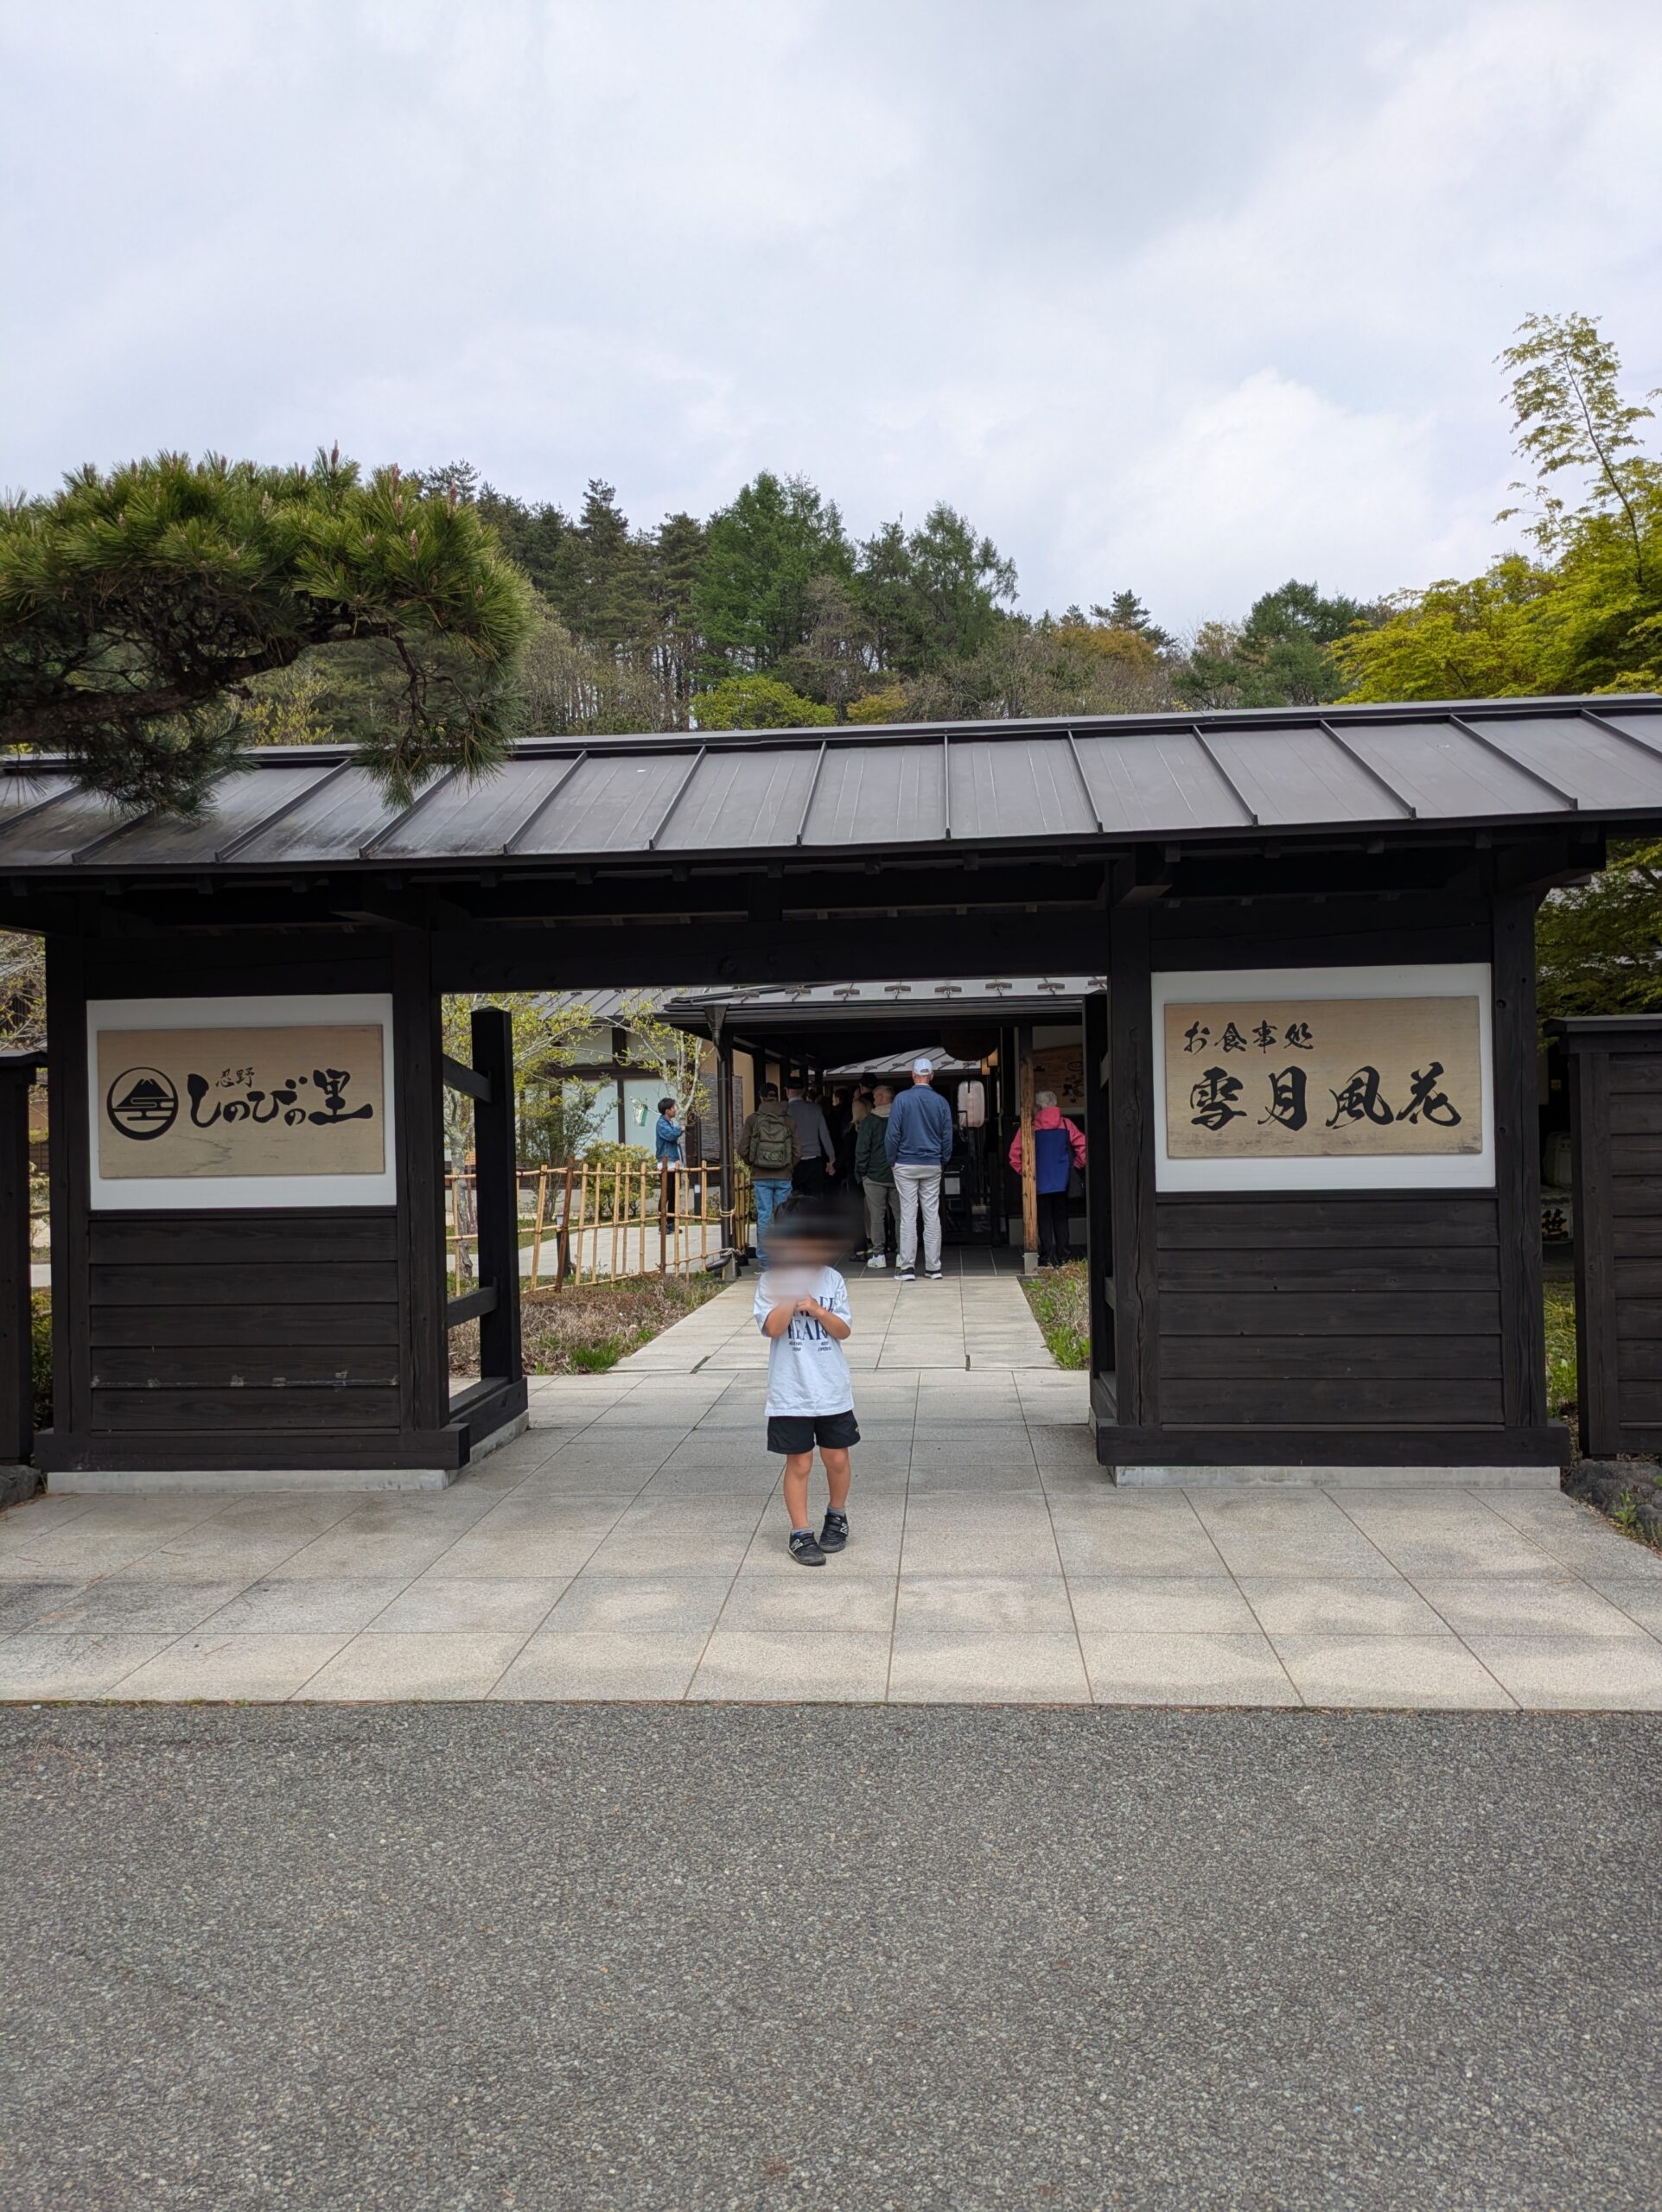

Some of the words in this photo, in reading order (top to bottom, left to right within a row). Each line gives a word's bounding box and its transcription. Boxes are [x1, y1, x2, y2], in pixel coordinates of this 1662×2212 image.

[1184, 1020, 1314, 1055] お食事処
[187, 1068, 373, 1128] しのびの里
[215, 1067, 255, 1088] 忍野
[1190, 1061, 1462, 1131] 雪月風花
